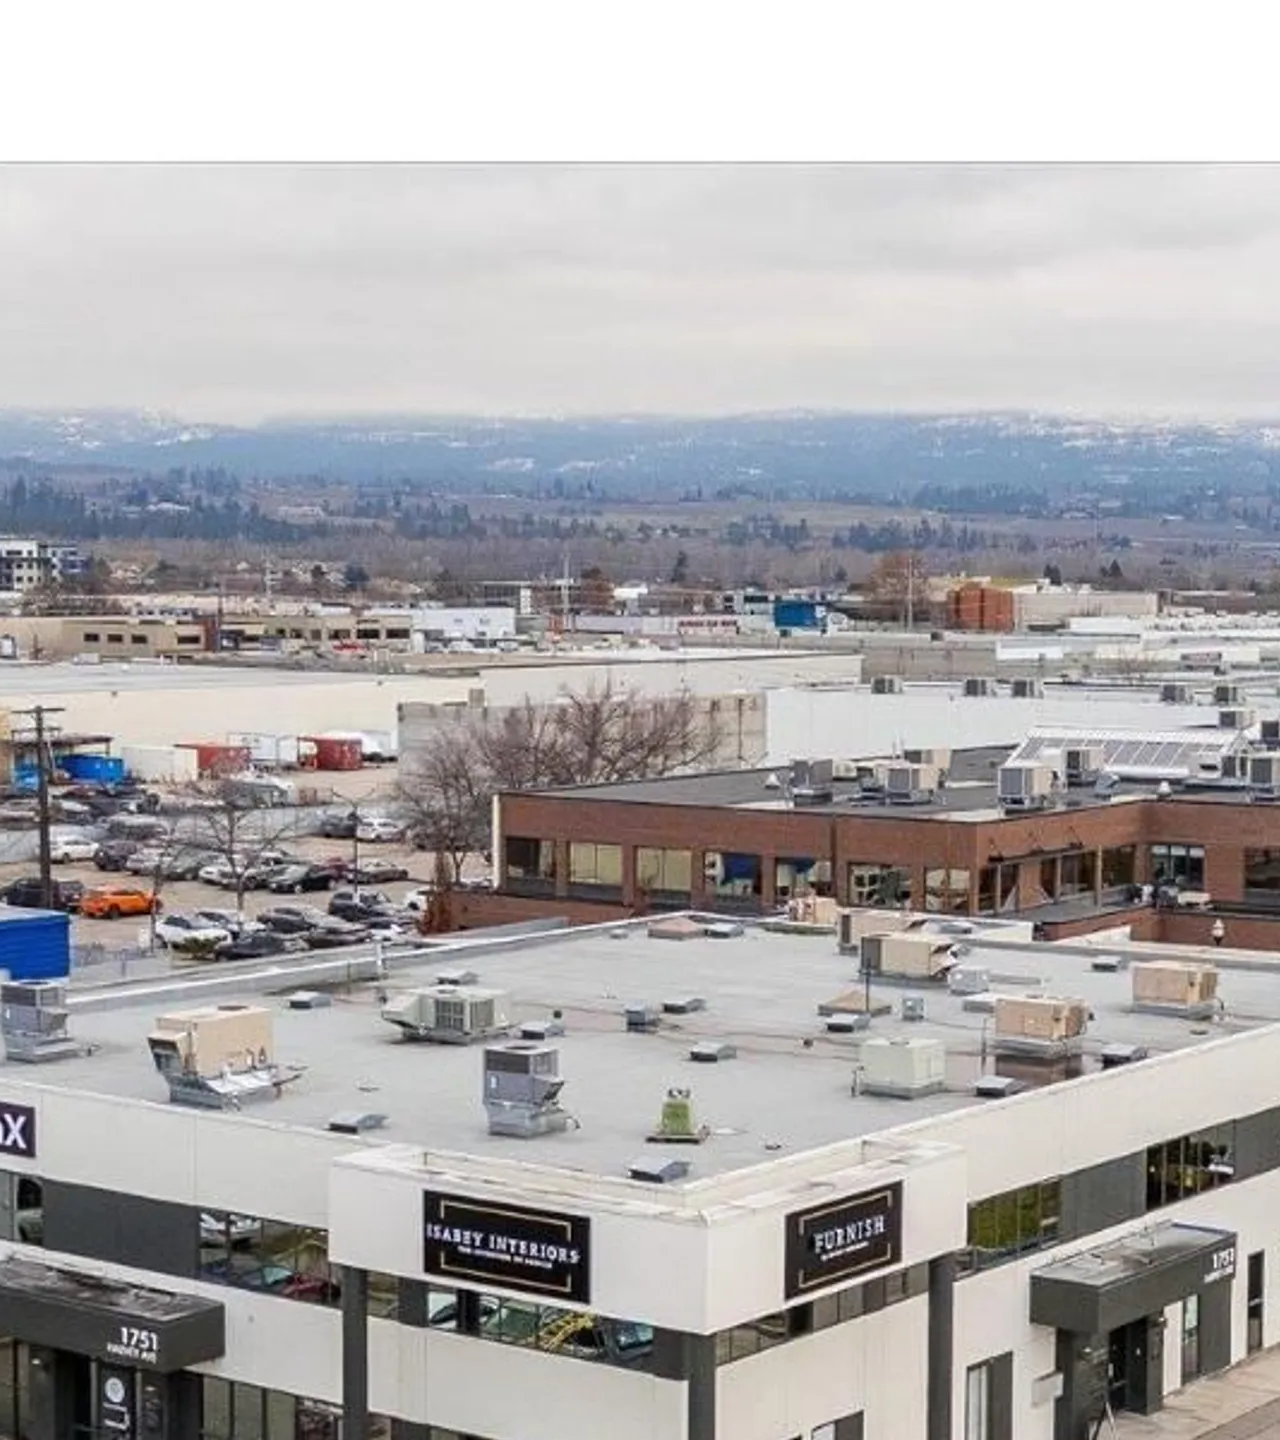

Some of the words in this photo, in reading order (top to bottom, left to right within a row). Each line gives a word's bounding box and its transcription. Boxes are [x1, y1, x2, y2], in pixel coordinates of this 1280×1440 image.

[812, 1214, 885, 1255] FURNISH
[488, 1235, 581, 1265] INTERIORS
[120, 1326, 158, 1351] 1751
